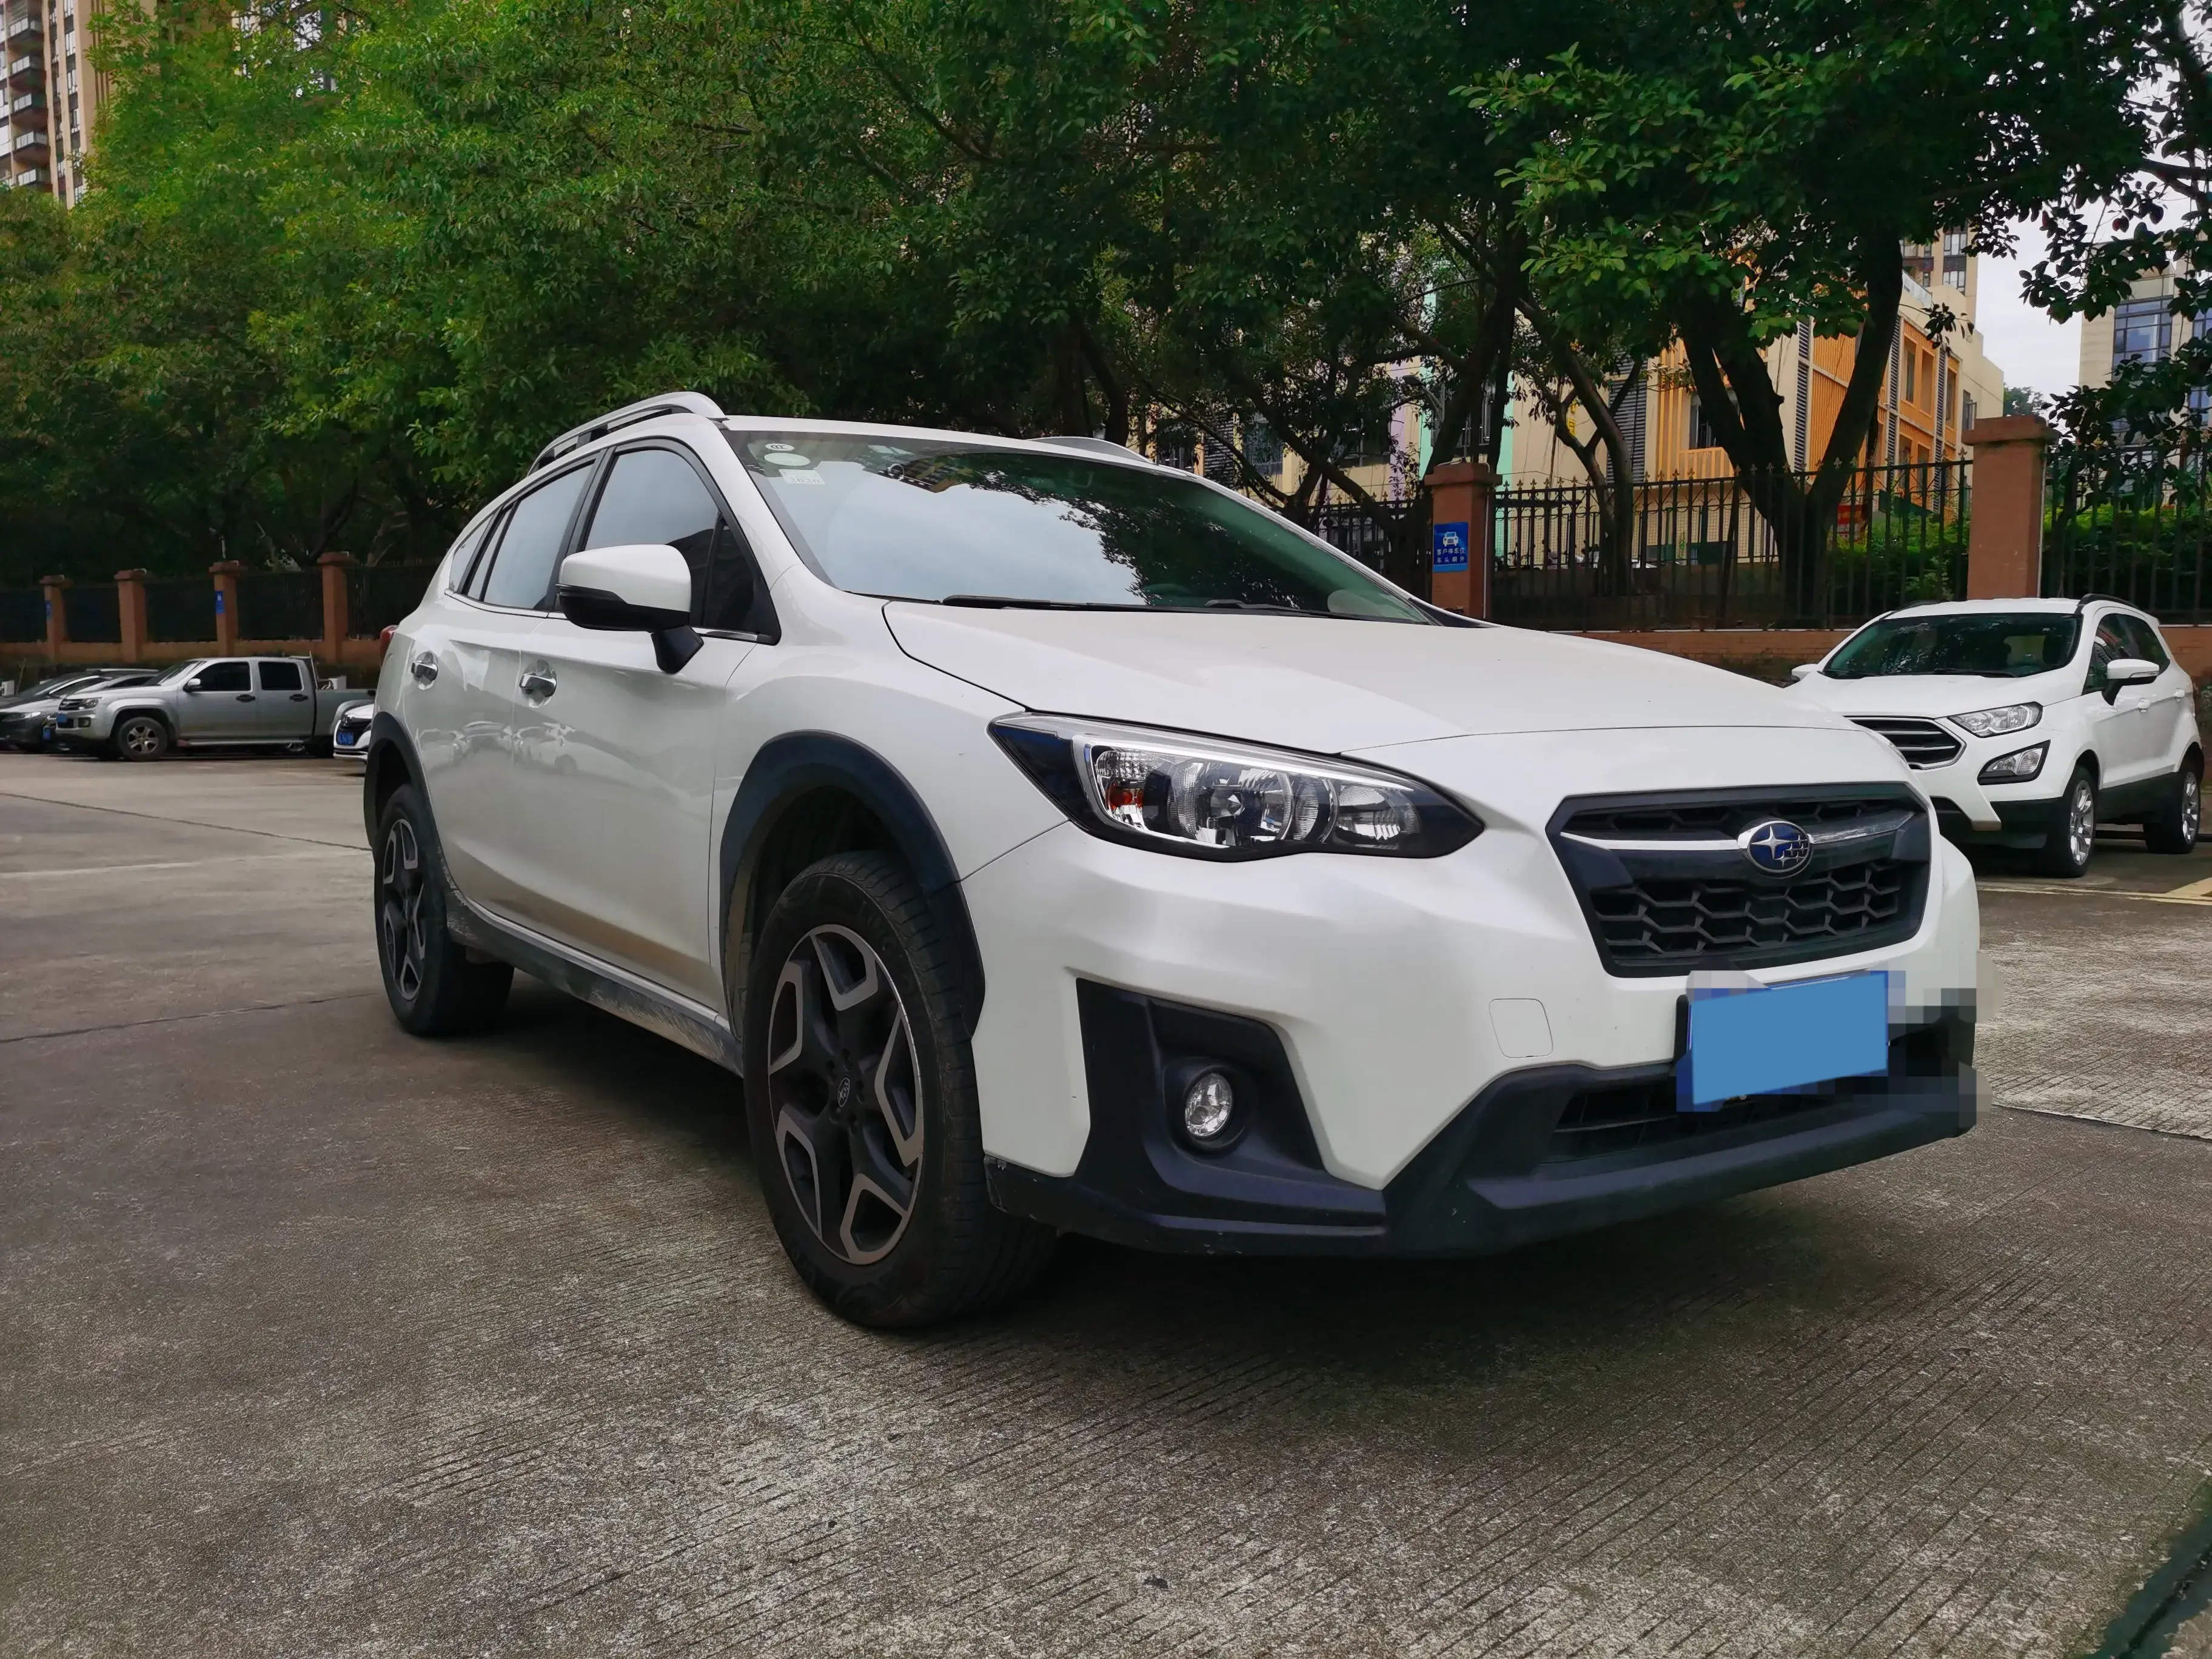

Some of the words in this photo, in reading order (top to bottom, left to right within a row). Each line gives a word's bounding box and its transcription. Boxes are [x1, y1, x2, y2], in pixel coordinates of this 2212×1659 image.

[1436, 547, 1465, 556] 客户停车位
